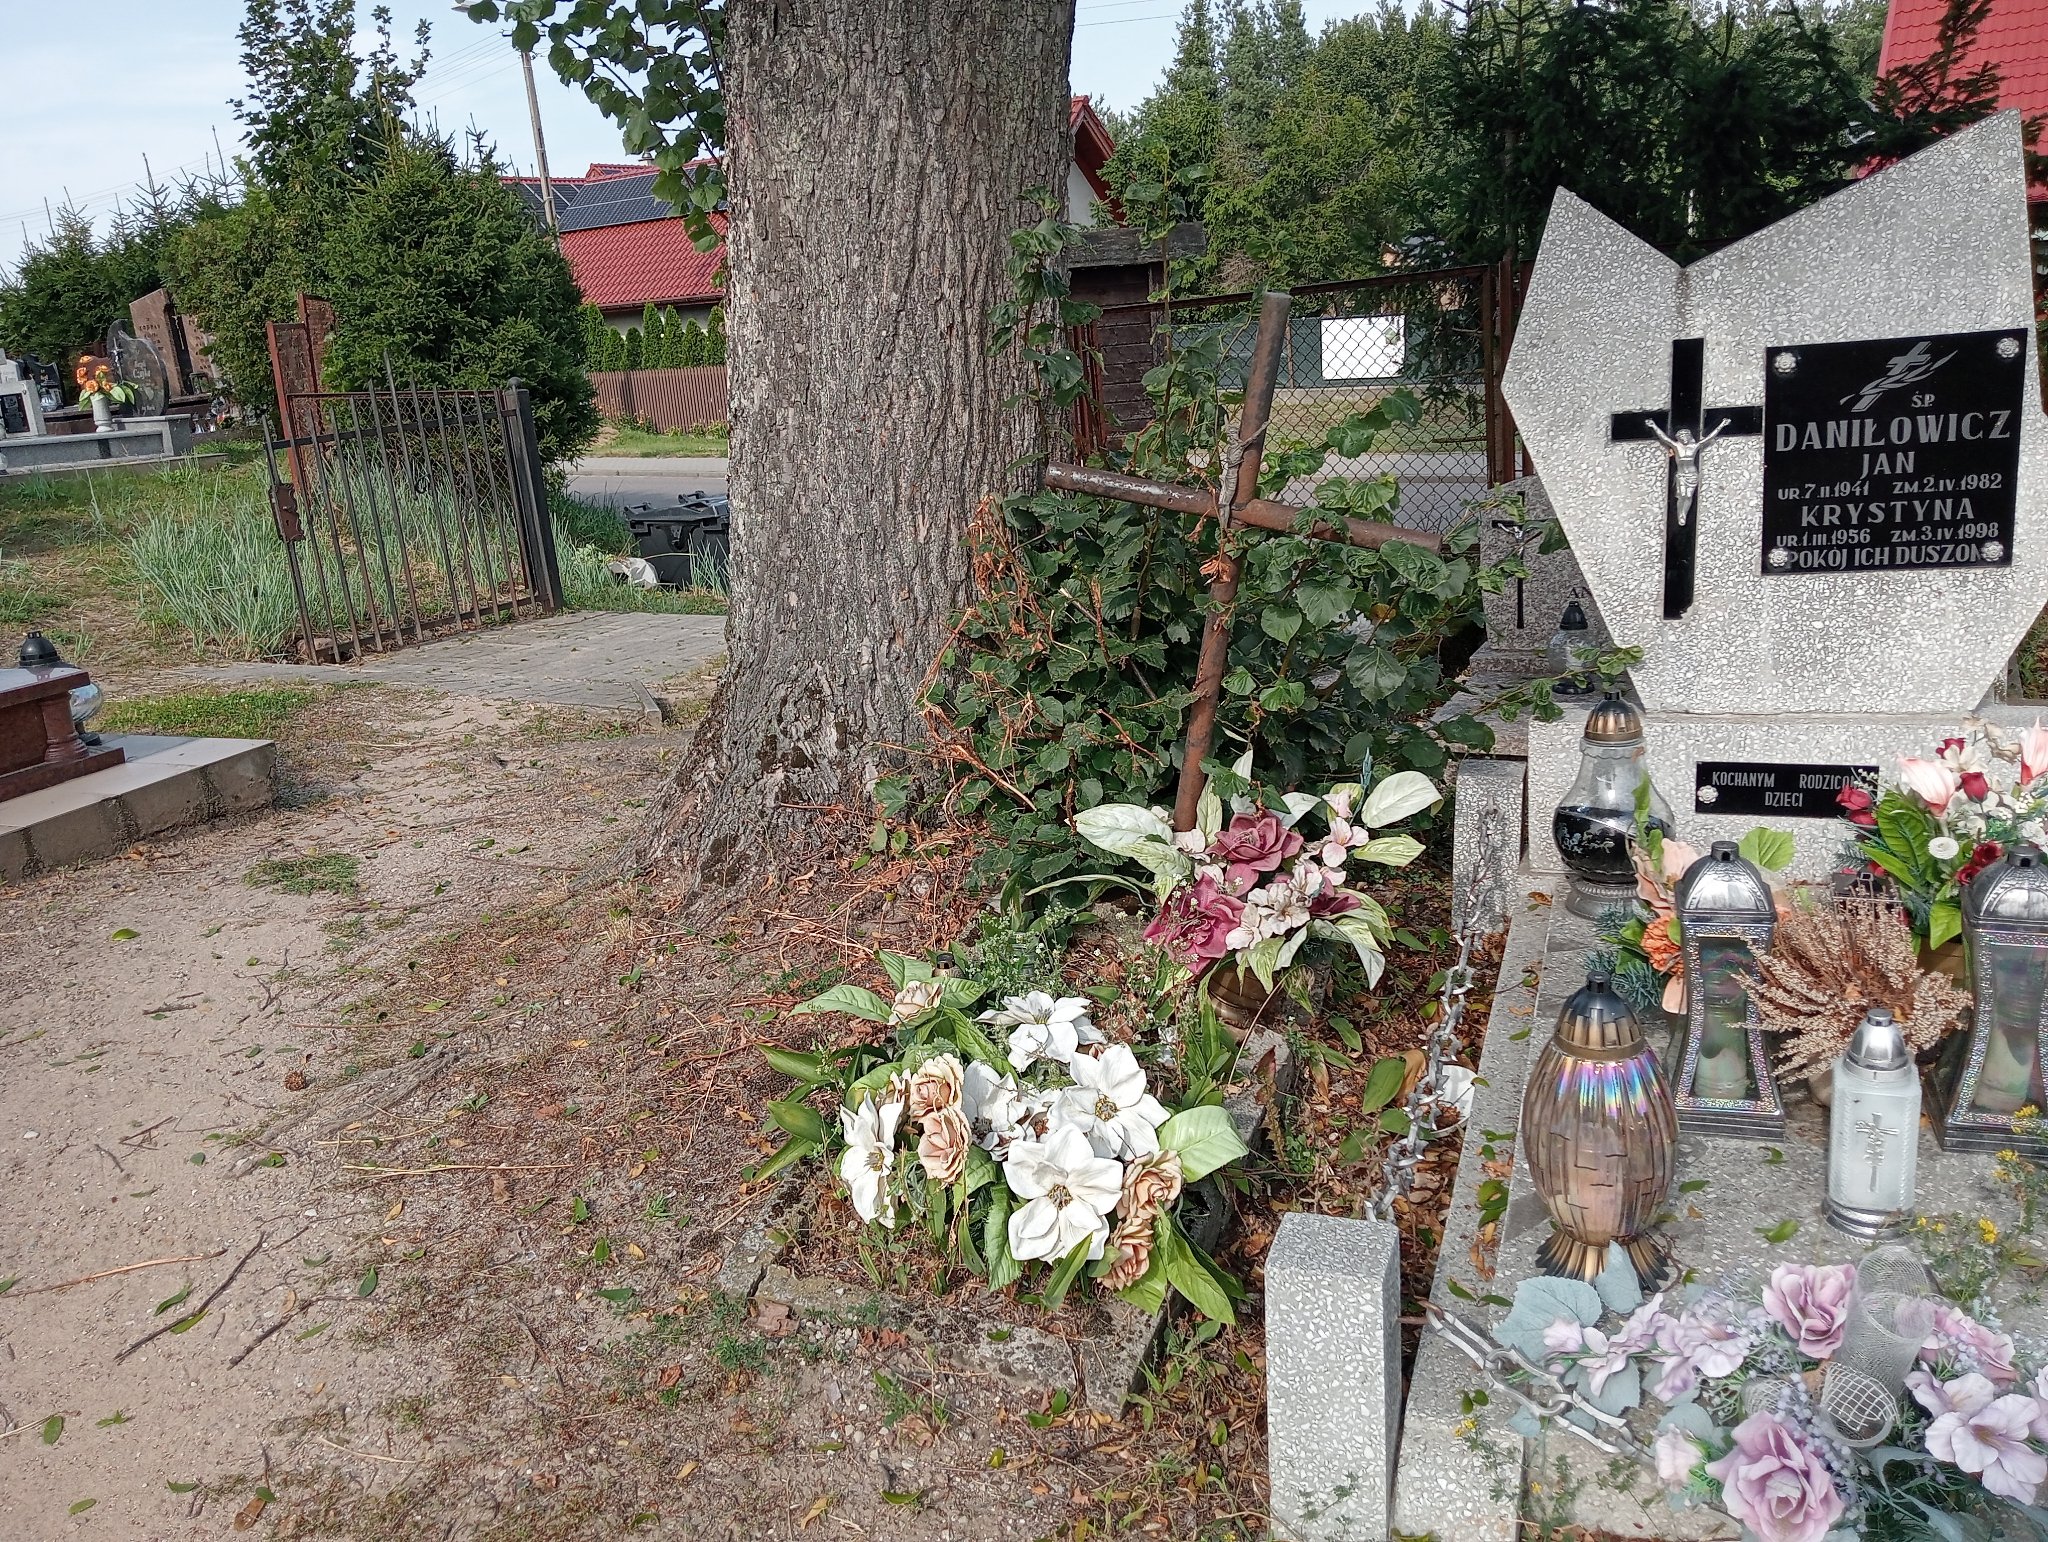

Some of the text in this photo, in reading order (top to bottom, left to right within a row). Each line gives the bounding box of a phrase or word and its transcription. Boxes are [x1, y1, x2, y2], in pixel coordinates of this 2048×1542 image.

[1775, 409, 2011, 452] DANIŁOWICZ
[1860, 451, 1915, 480] JAN
[1801, 497, 1975, 527] KRYSTYNA
[1854, 546, 1890, 567] ICH
[1712, 771, 1775, 788] KOCHANYM
[1764, 791, 1803, 807] DZIECI
